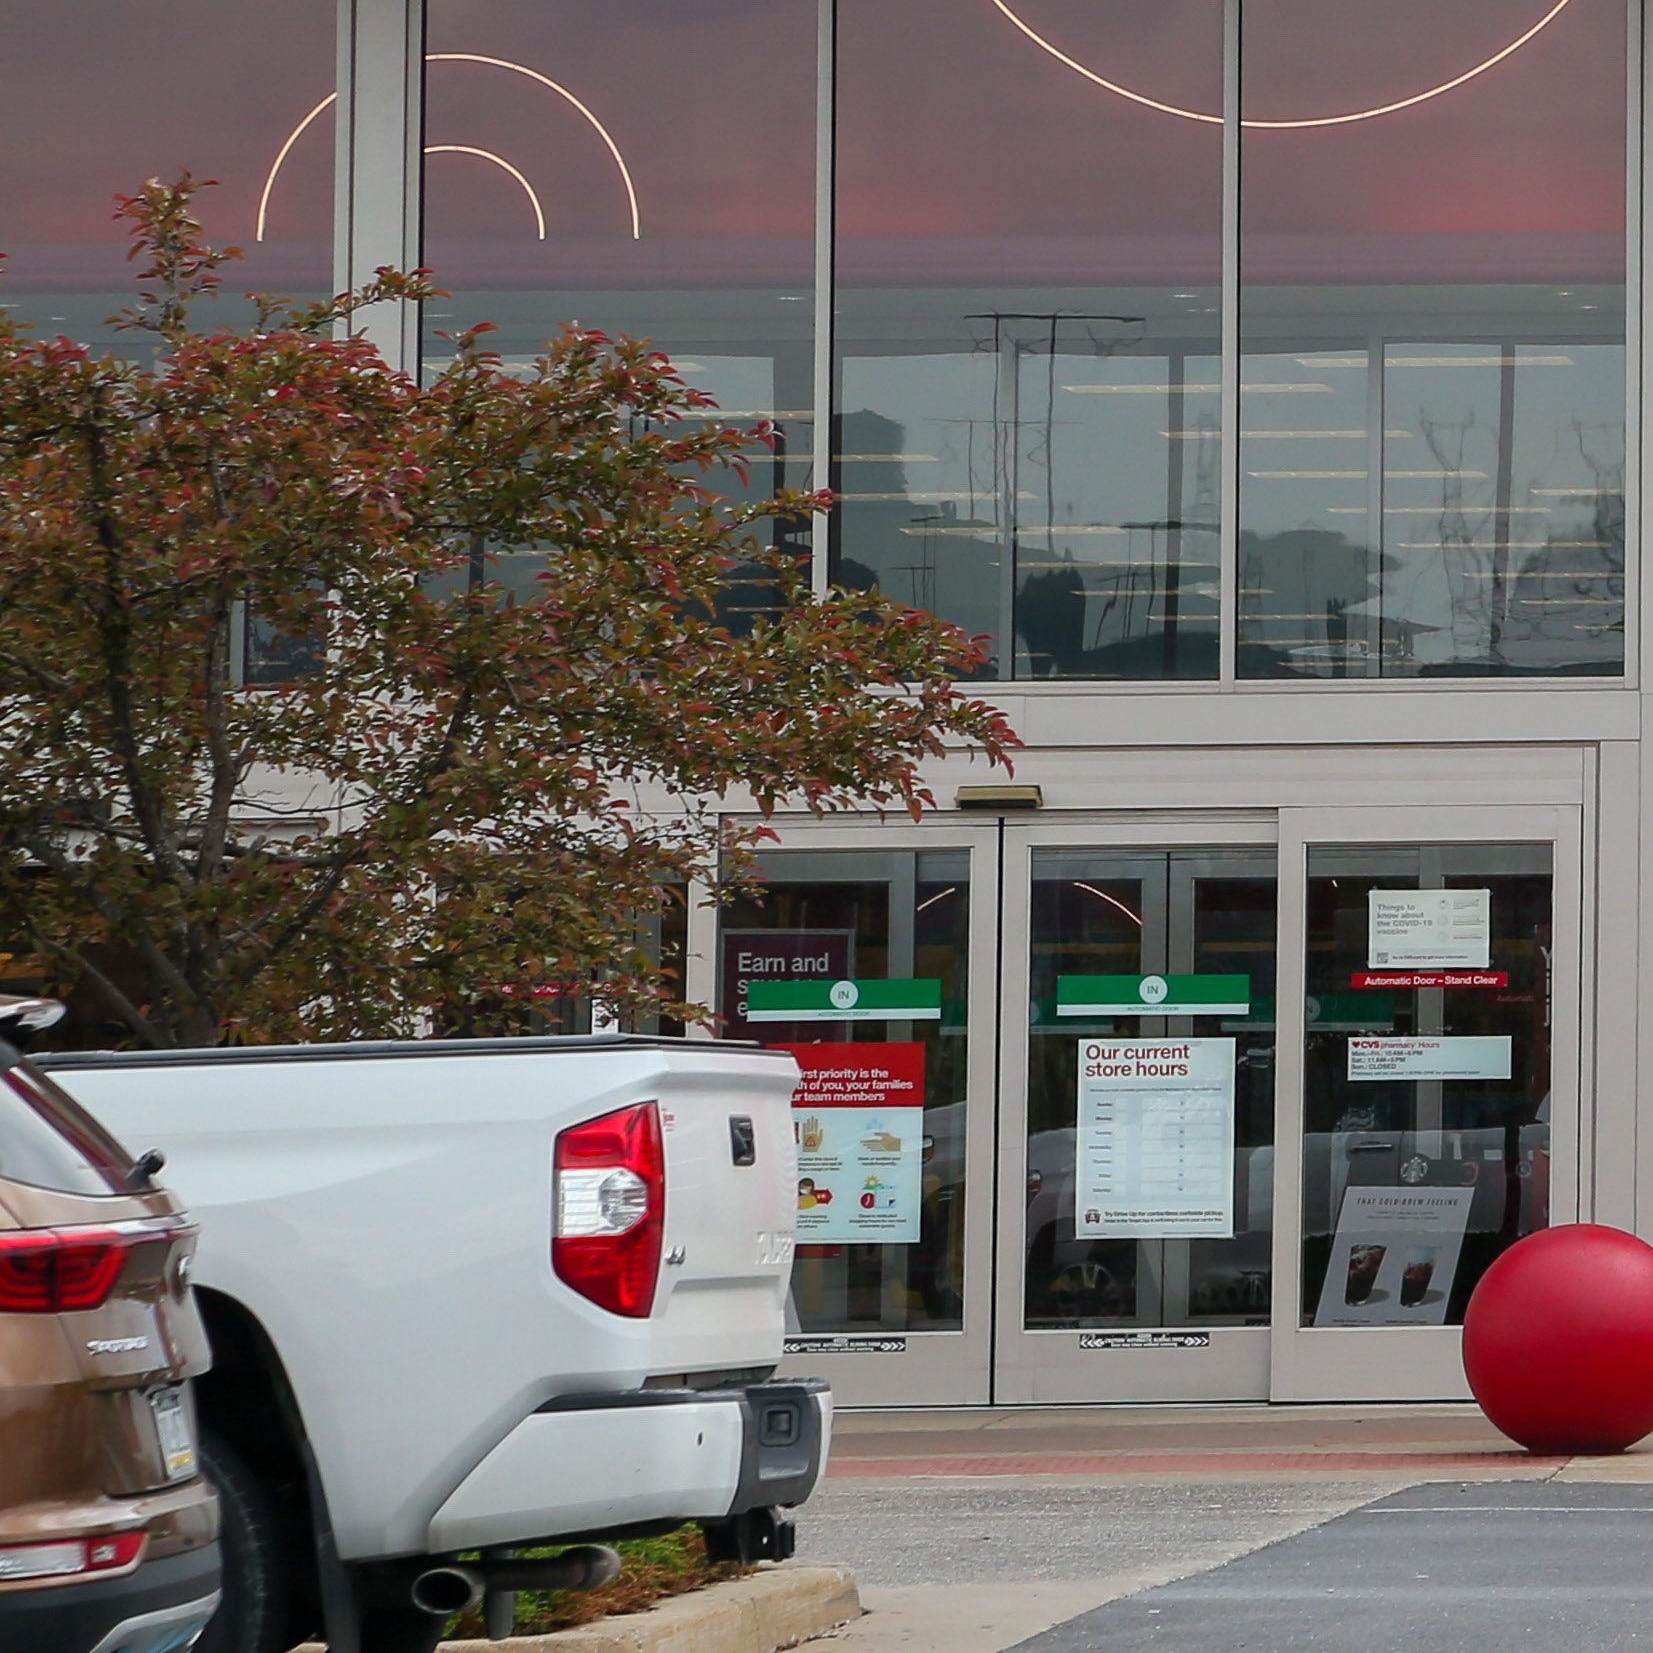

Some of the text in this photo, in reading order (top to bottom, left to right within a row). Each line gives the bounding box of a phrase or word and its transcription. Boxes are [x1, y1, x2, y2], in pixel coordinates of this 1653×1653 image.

[738, 952, 829, 972] Earn and
[1364, 976, 1411, 985] Automatic
[1413, 975, 1436, 985] Door
[1444, 975, 1472, 985] Stand
[1473, 975, 1498, 984] Clear
[837, 991, 849, 1000] IN
[1146, 985, 1159, 994] IN
[1085, 1044, 1190, 1060] Our current
[798, 1068, 889, 1080] irst priority is the
[1085, 1061, 1189, 1077] store hours
[809, 1080, 821, 1089] of
[821, 1082, 845, 1092] you,
[846, 1082, 871, 1092] your
[872, 1079, 913, 1089] families
[804, 1092, 832, 1101] team
[833, 1092, 885, 1101] members
